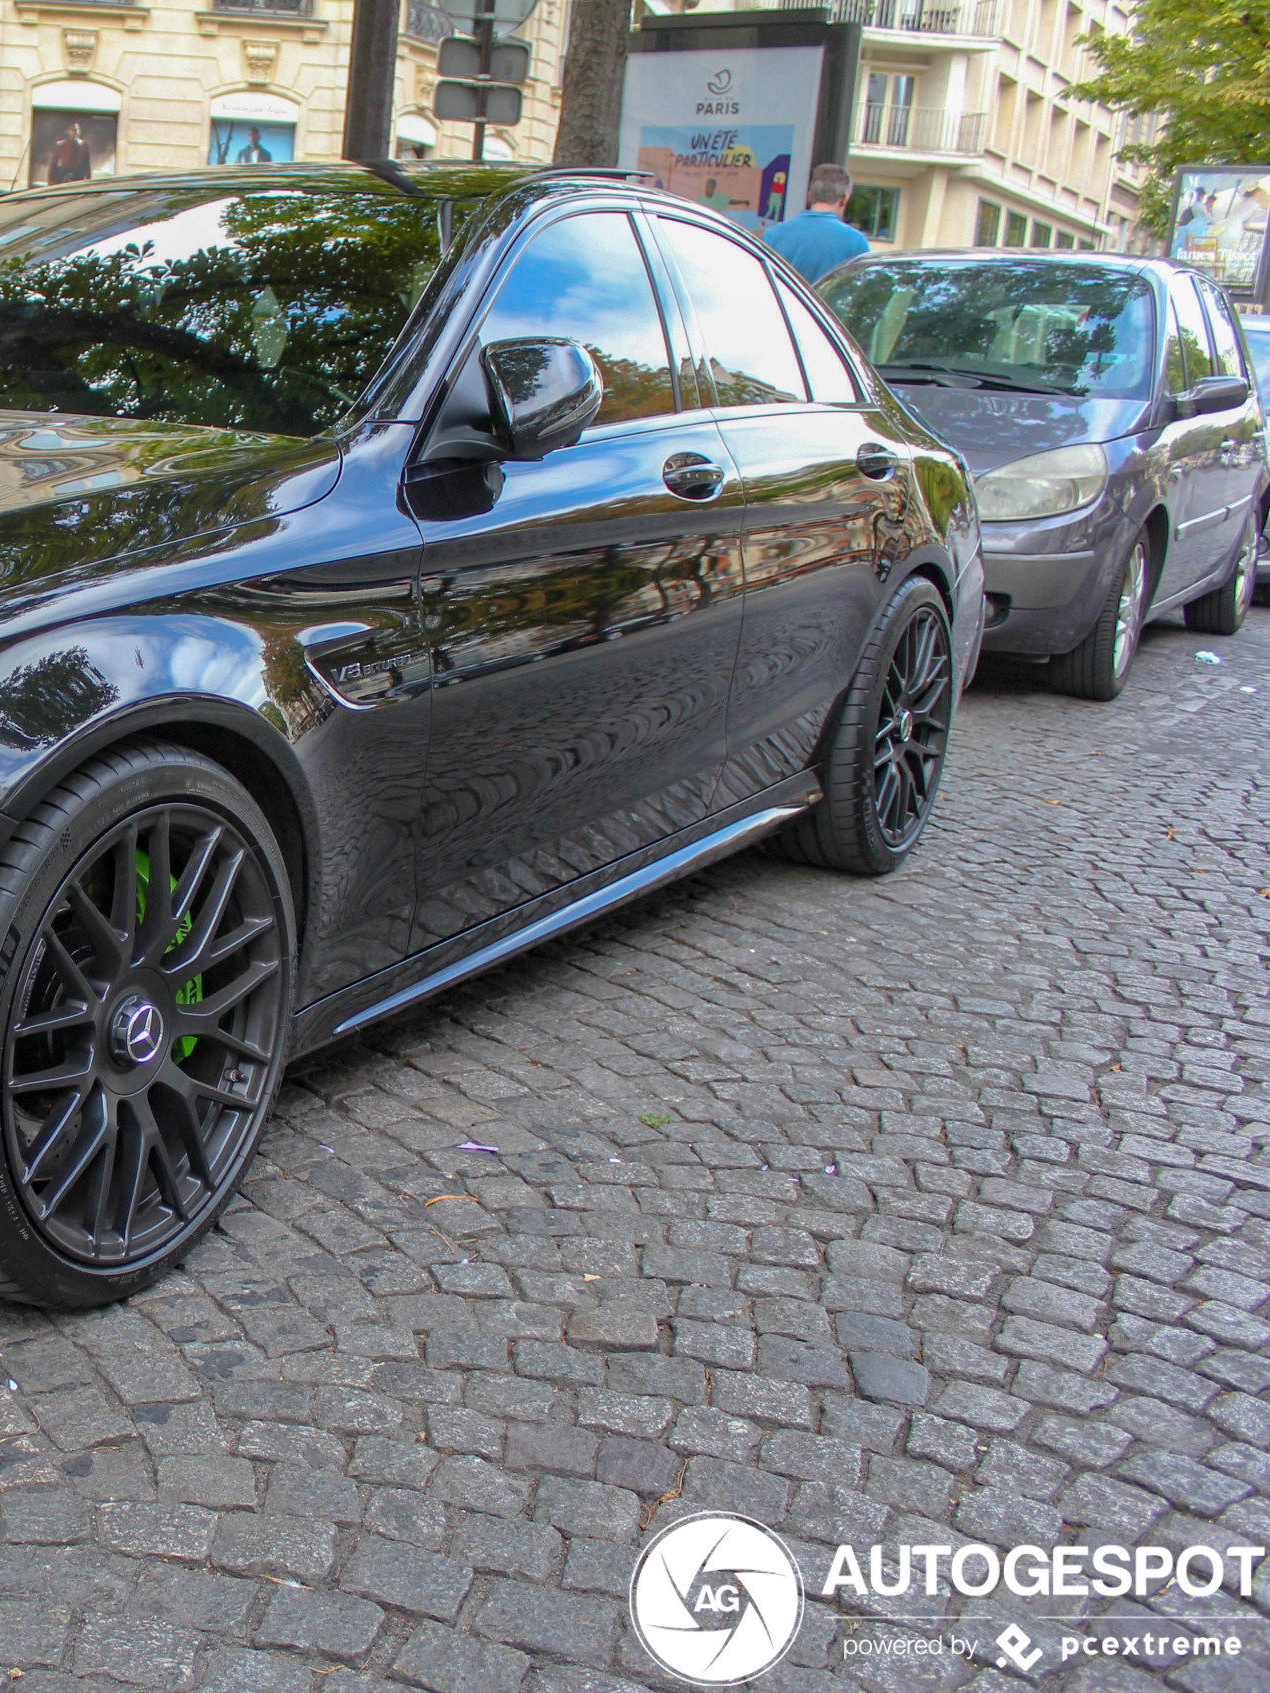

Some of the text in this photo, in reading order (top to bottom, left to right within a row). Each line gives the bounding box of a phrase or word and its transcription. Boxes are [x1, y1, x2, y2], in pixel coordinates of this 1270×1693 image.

[695, 102, 740, 115] PARIS
[691, 132, 711, 150] UN
[674, 150, 752, 169] PARTICULIER
[330, 655, 411, 682] V8 BITURBO
